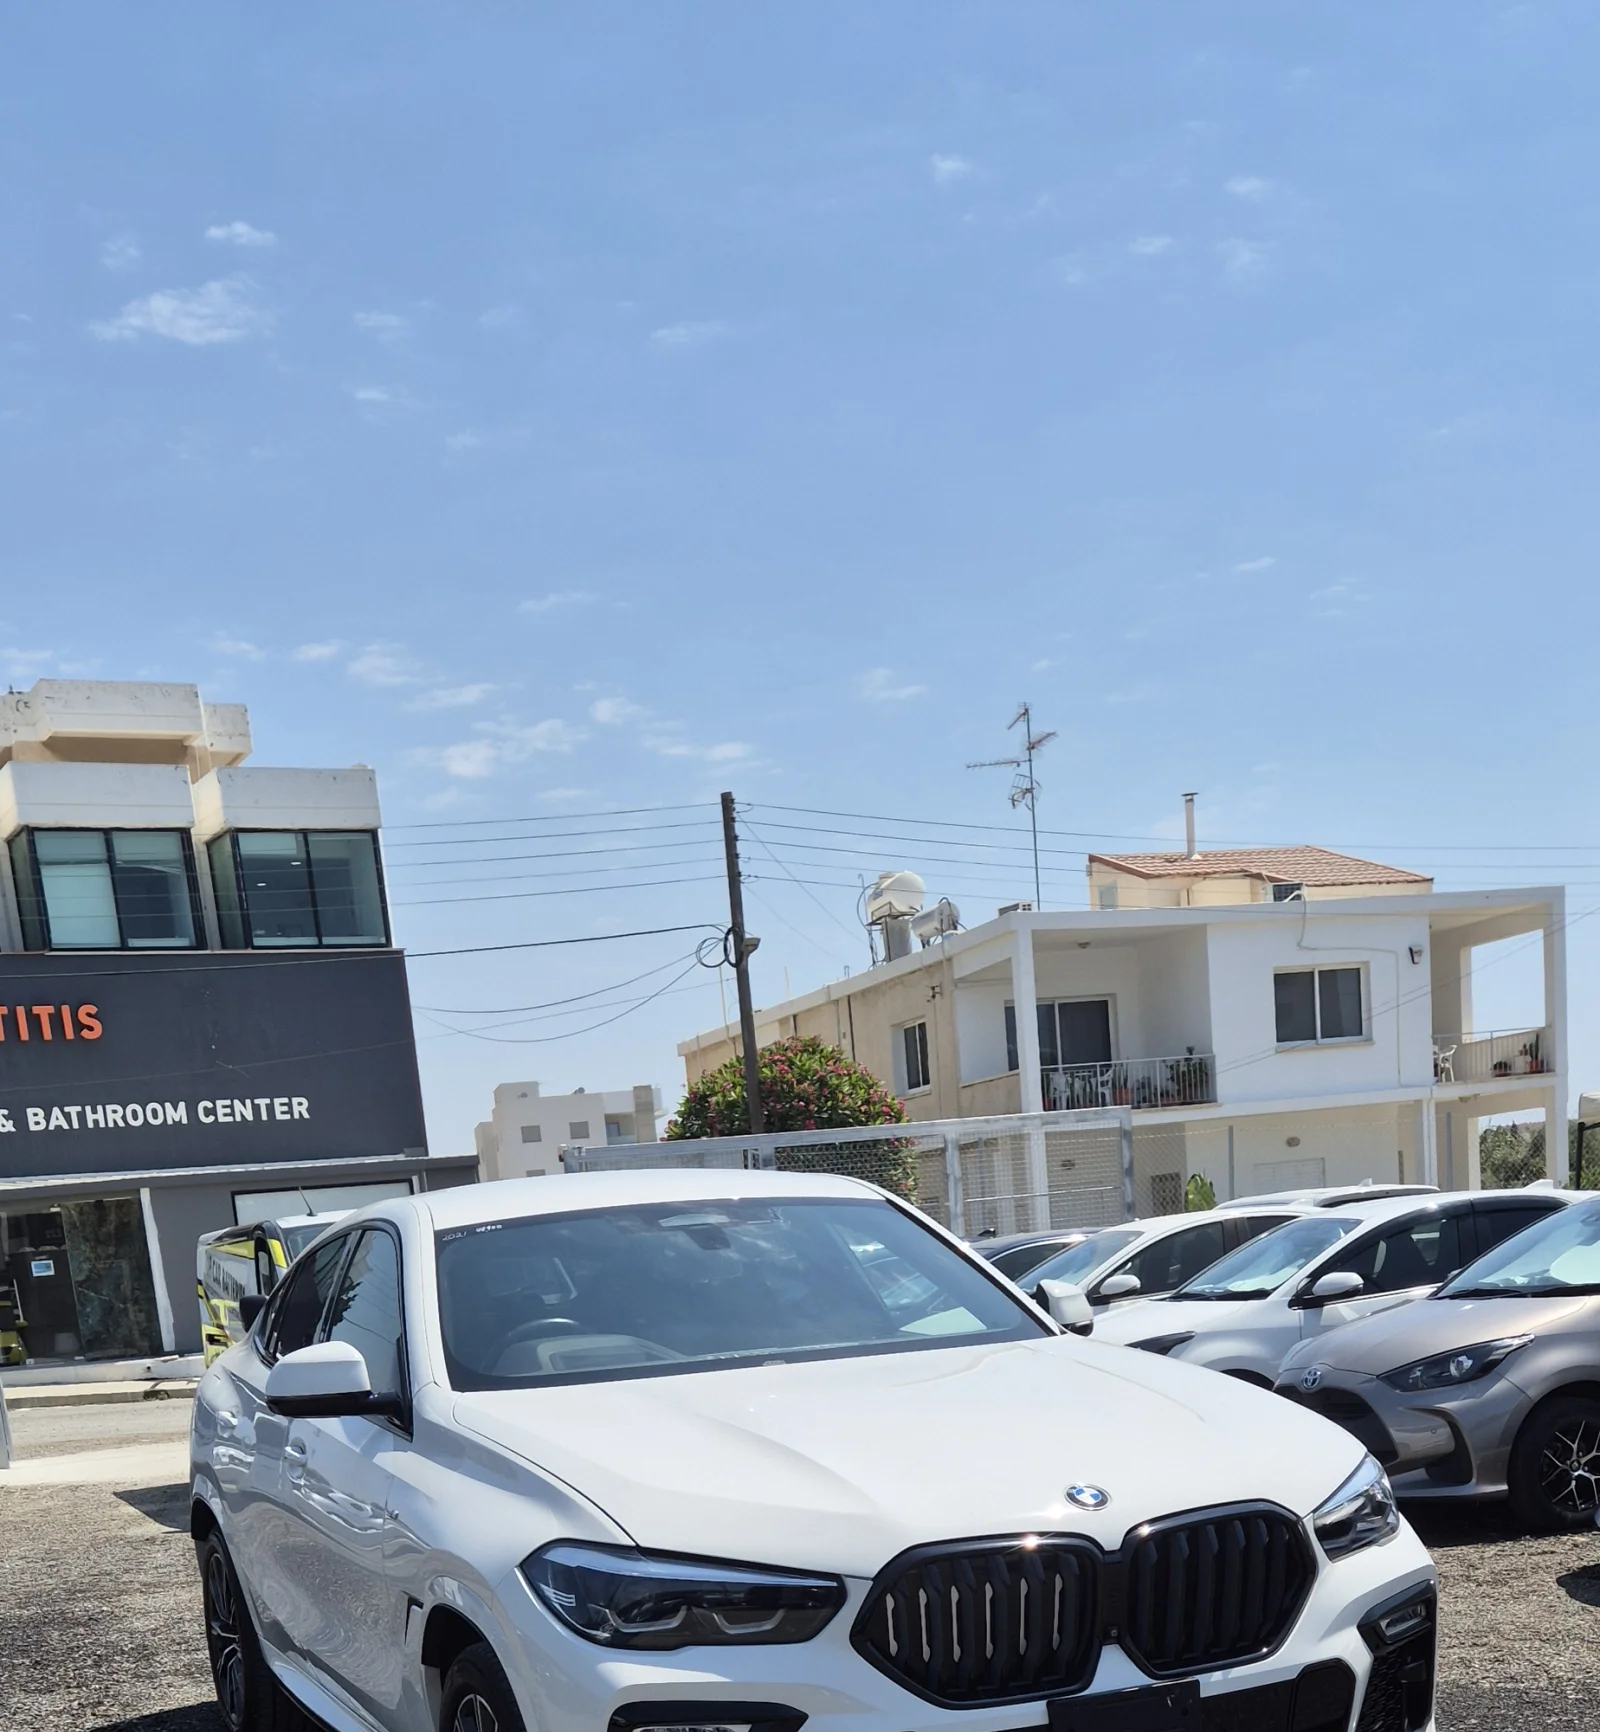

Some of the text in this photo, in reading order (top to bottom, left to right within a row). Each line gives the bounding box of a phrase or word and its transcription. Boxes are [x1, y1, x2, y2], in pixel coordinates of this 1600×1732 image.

[0, 1096, 310, 1133] & BATHROOM CENTER
